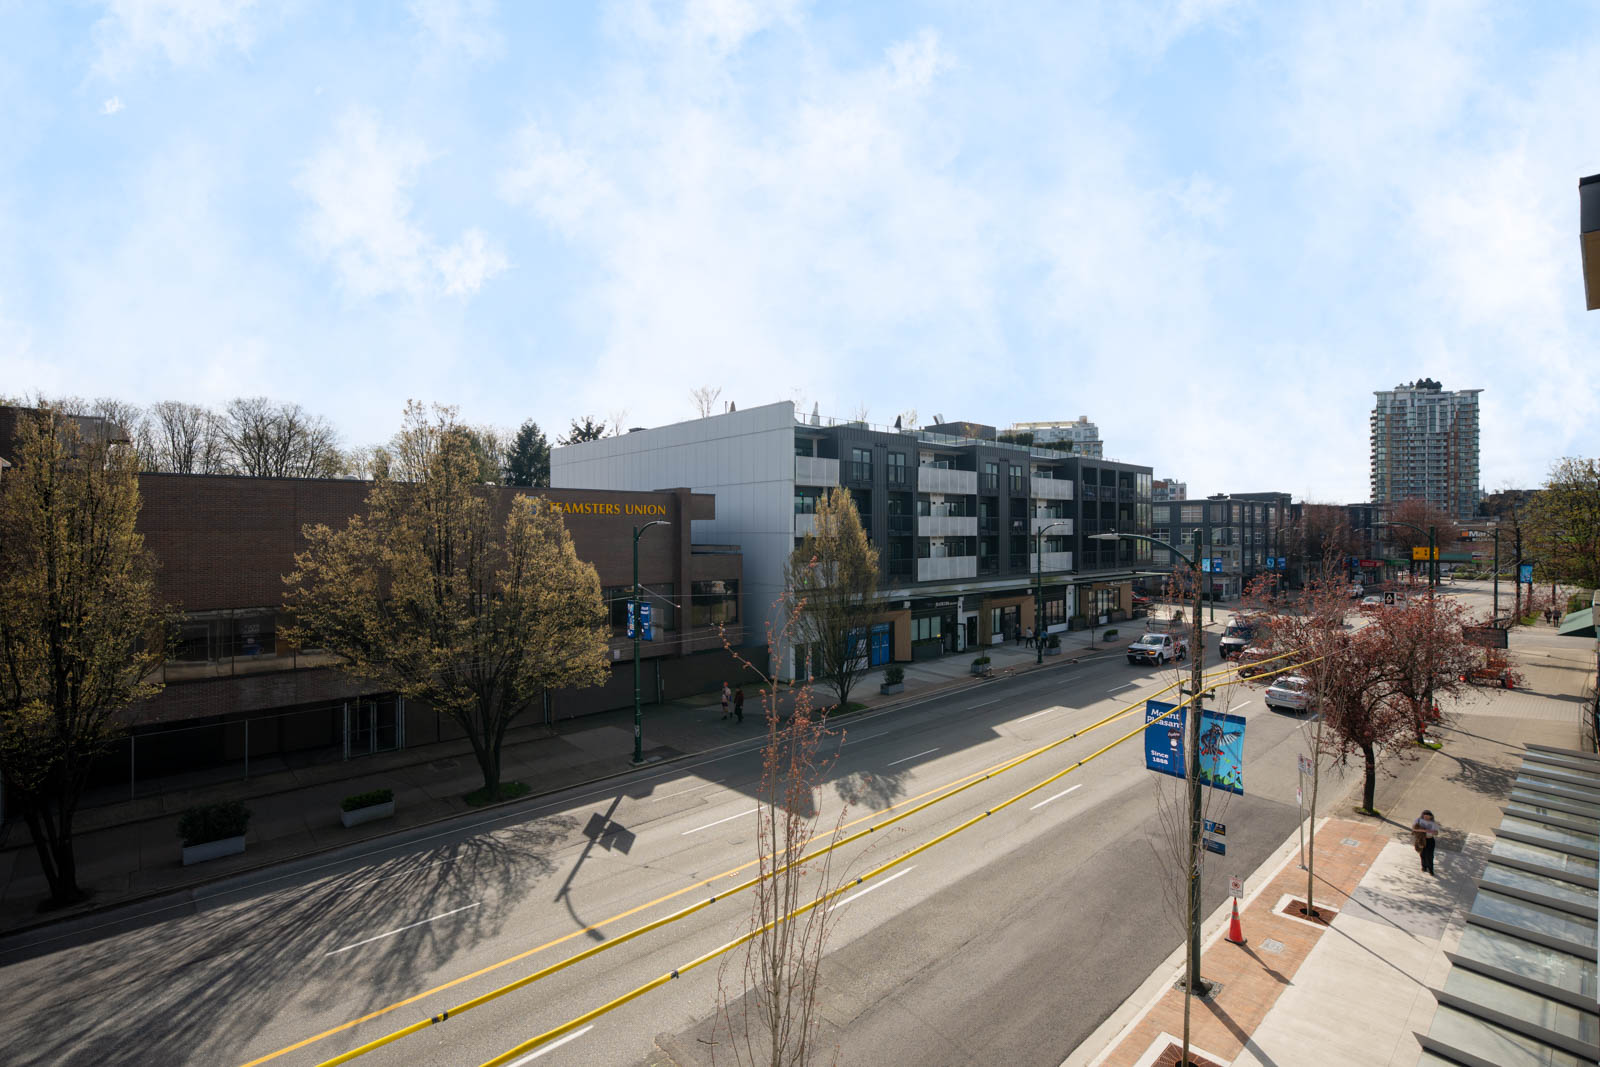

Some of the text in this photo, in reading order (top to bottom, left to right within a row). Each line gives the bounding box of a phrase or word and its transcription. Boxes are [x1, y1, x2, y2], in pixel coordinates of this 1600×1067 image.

[548, 502, 666, 515] TEAMSTERS UNION
[1151, 750, 1169, 759] Since
